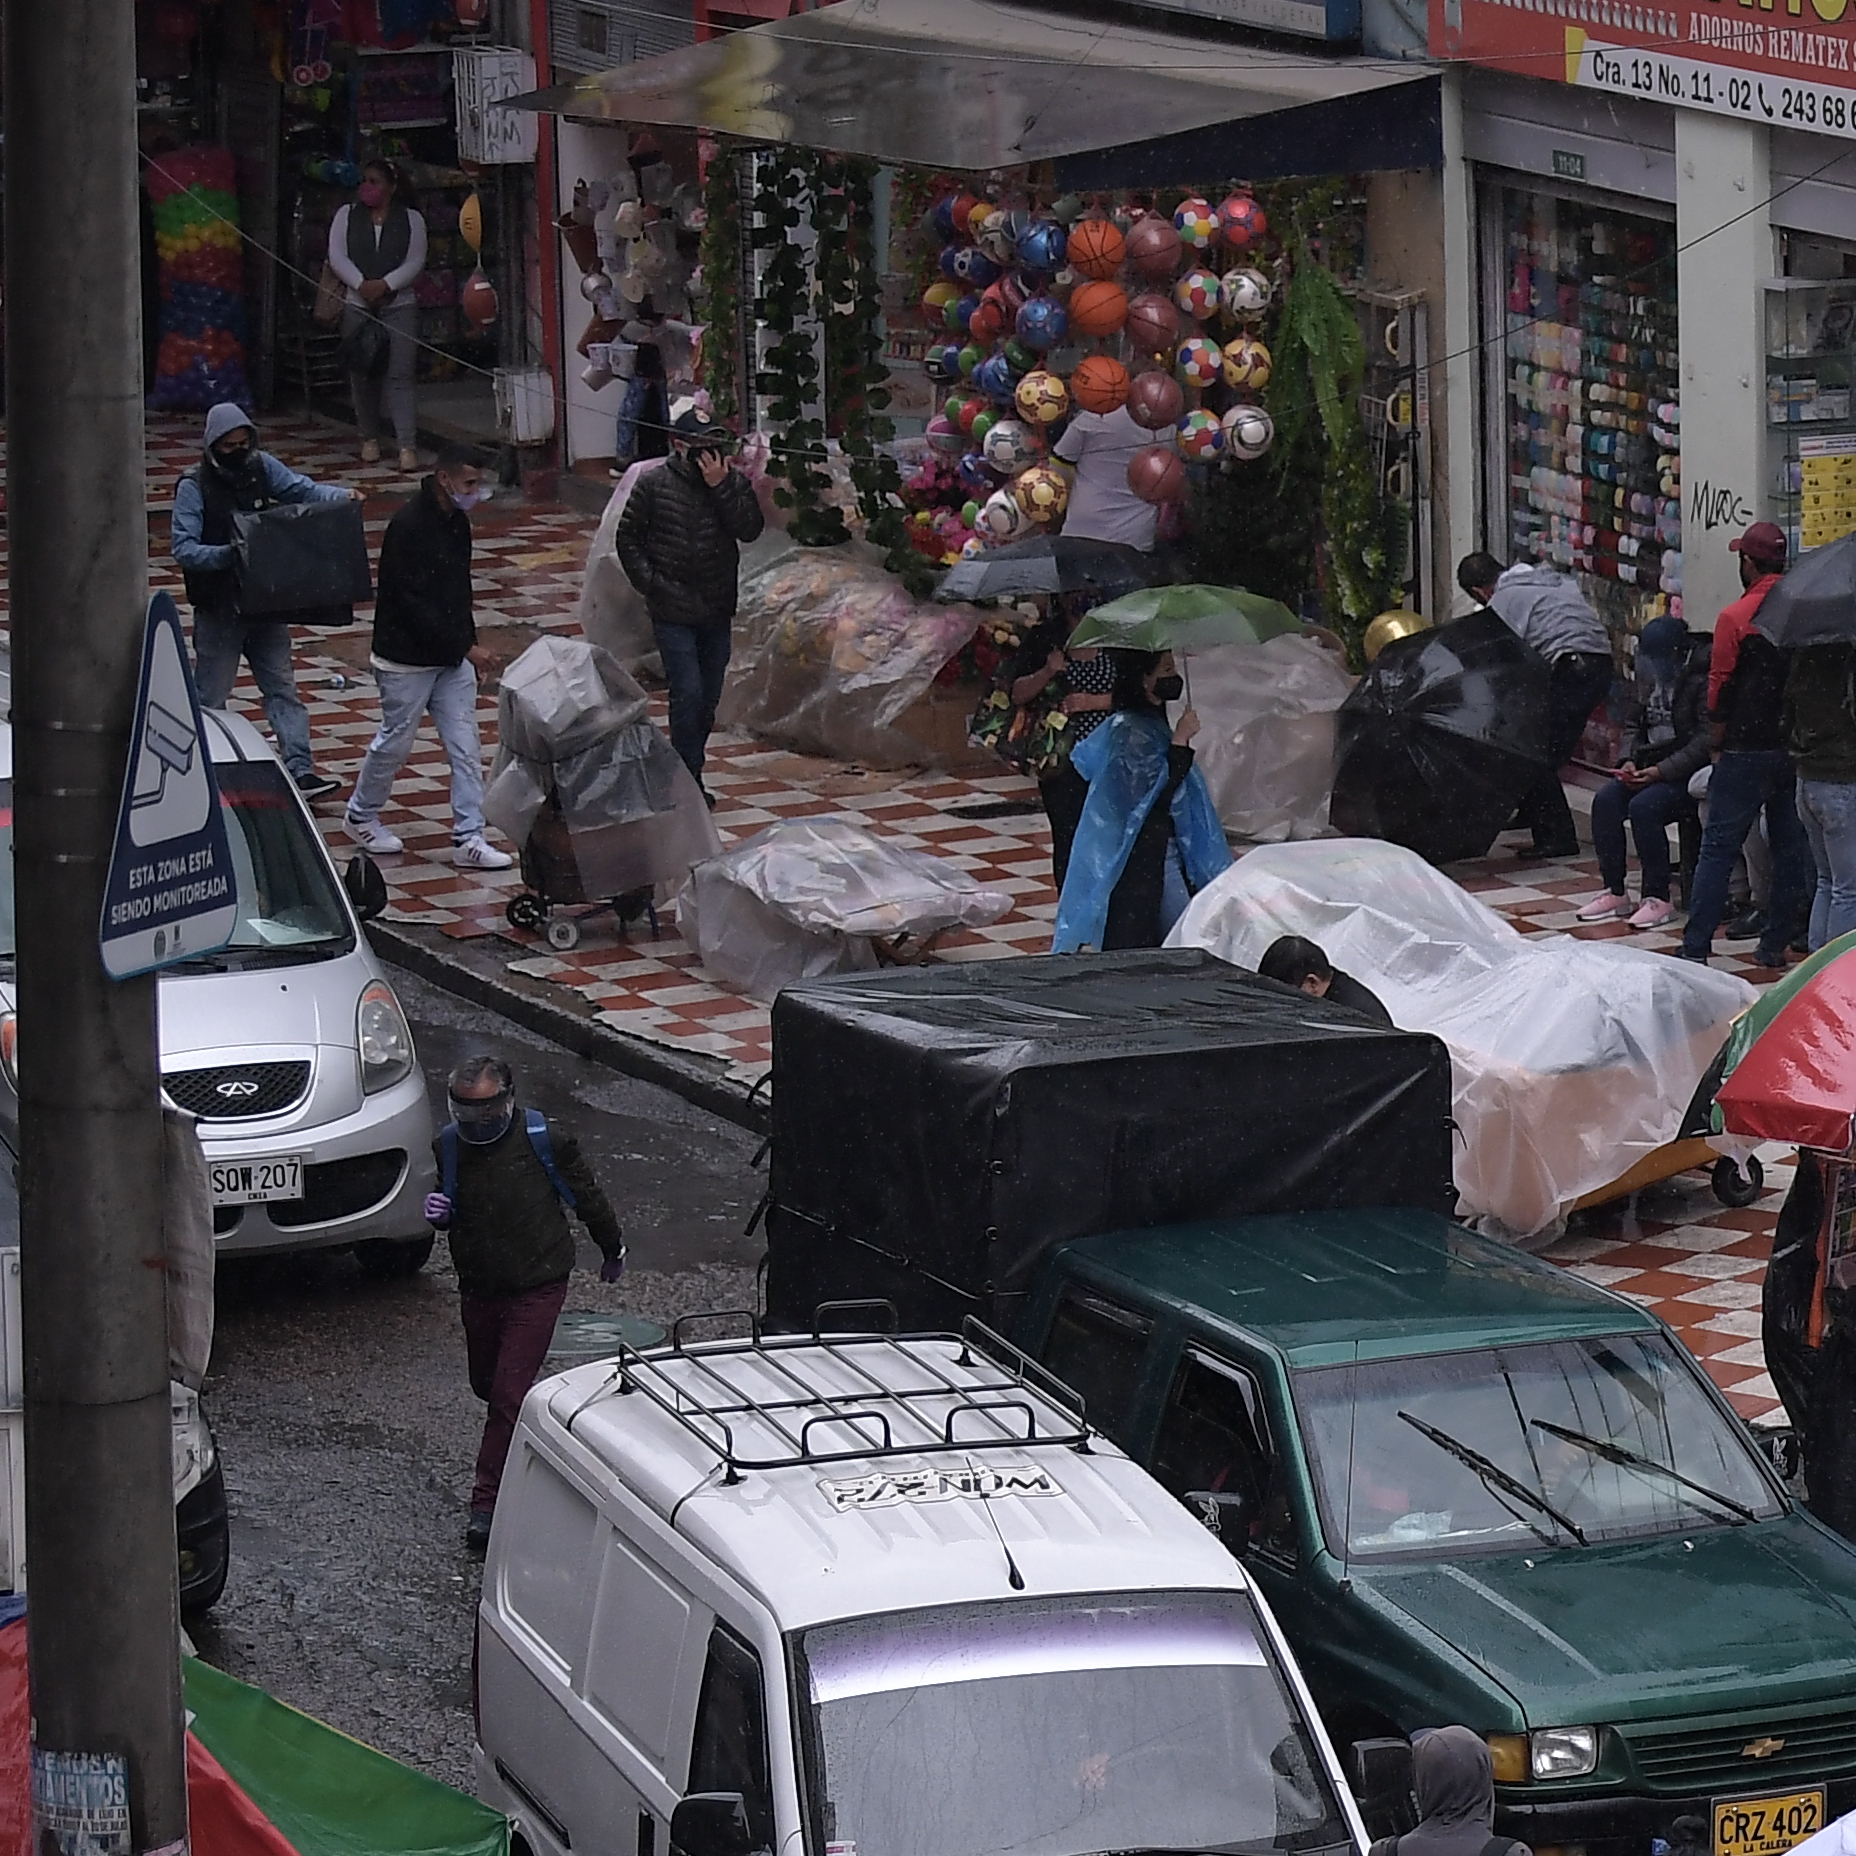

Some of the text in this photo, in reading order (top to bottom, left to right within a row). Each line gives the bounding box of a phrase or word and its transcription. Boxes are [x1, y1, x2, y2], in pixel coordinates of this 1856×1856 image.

[1689, 12, 1764, 57] ADORNOS
[1768, 28, 1849, 71] REMATEX
[1593, 50, 1626, 87] Cra.
[1631, 58, 1653, 92] 13
[1658, 66, 1686, 99] No.
[1691, 71, 1714, 104] 11
[1729, 78, 1751, 112] 02
[1781, 88, 1817, 125] 243
[1822, 97, 1847, 129] 68
[129, 843, 214, 890] ESTA ZONA ESTÁ
[111, 875, 229, 925] SIENDO MONITOREADA
[1759, 1837, 1794, 1852] CALERA
